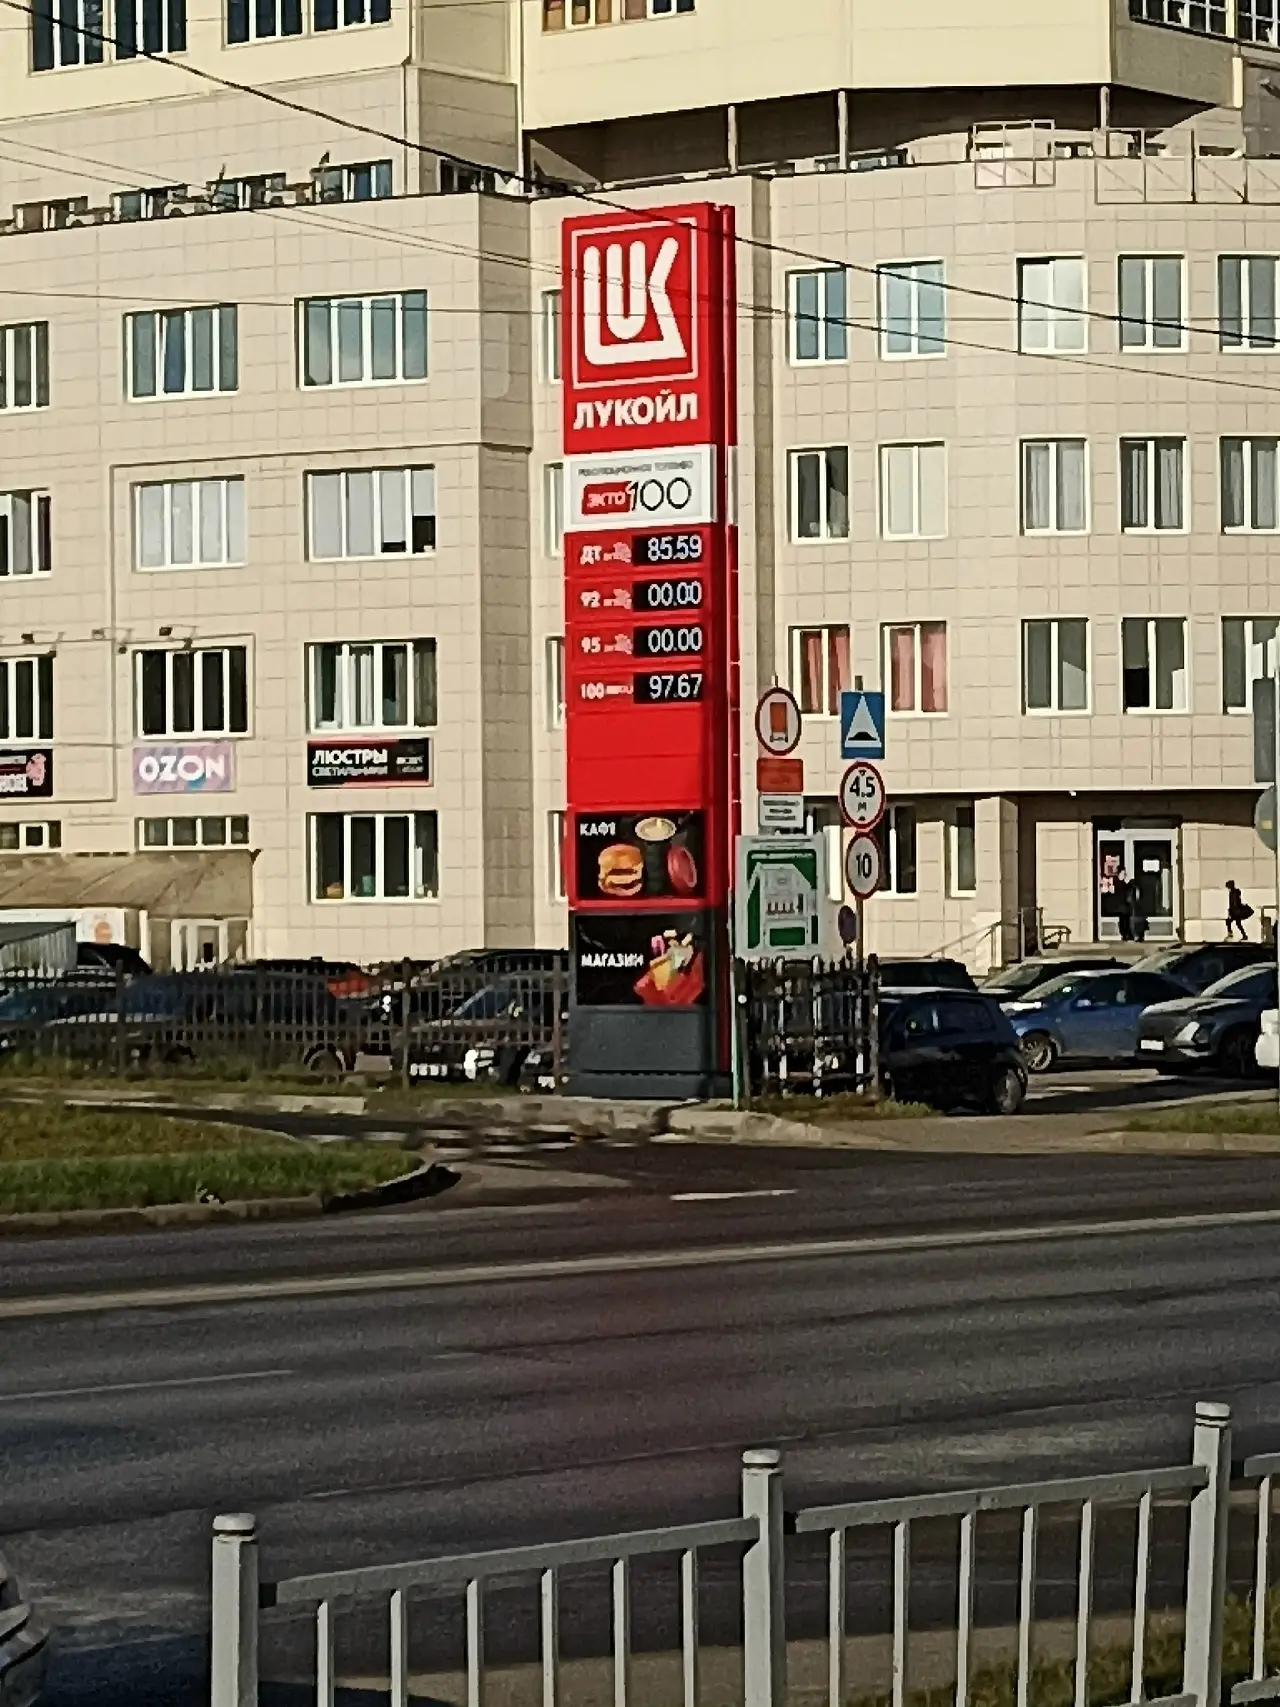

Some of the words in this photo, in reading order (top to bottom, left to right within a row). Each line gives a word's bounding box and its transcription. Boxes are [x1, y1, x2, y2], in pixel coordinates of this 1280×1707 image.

[573, 389, 698, 430] ЛУКОЙЛ
[580, 545, 602, 565] ДТ
[647, 534, 702, 561] 85.59
[647, 580, 702, 607] 00.00
[581, 636, 601, 653] 95
[647, 627, 702, 653] 00.00
[581, 682, 605, 699] 100
[649, 673, 702, 699] 97.67
[138, 755, 225, 782] OZON
[312, 749, 388, 765] ЛЮСТРЫ
[856, 852, 873, 879] 10
